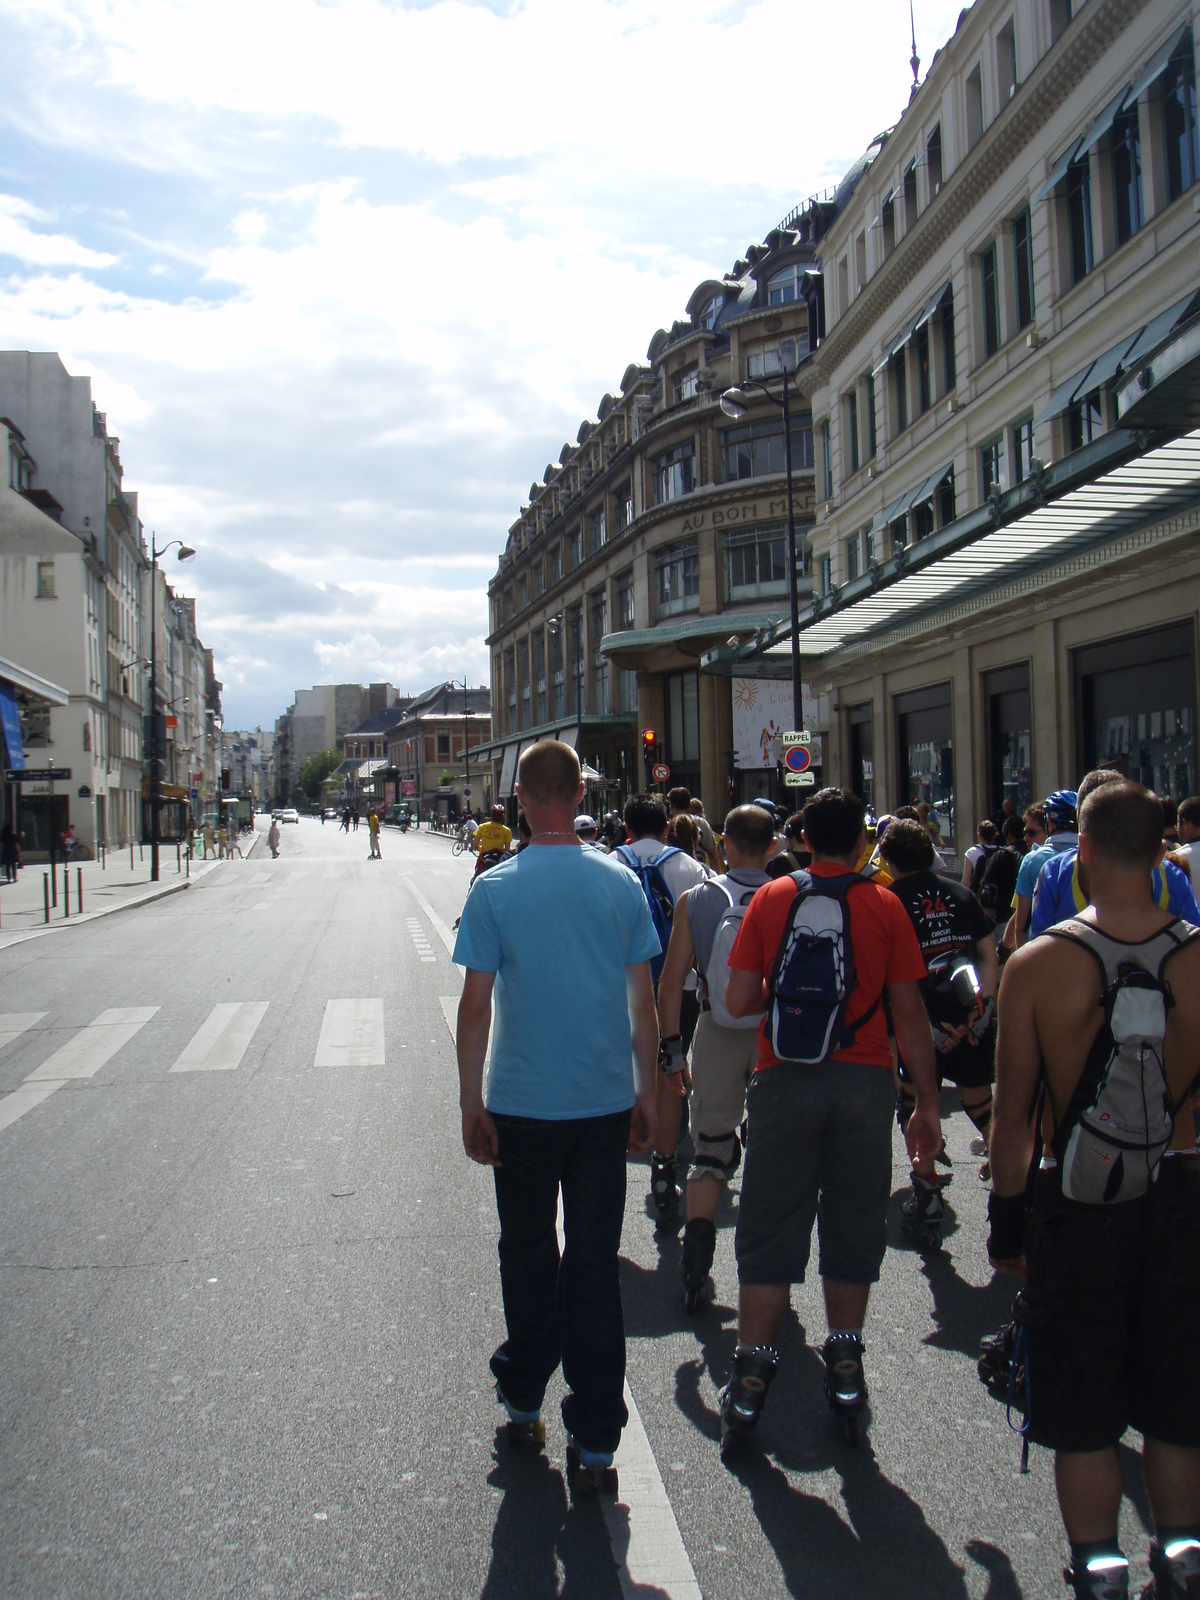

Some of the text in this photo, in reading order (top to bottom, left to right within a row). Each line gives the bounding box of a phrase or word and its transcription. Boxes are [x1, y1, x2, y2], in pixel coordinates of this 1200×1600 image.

[682, 514, 704, 532] AU
[712, 504, 757, 525] BON
[922, 897, 947, 914] 24
[926, 911, 949, 920] ROLLERS
[931, 928, 951, 938] CIRCUIT
[930, 936, 952, 946] HEURES
